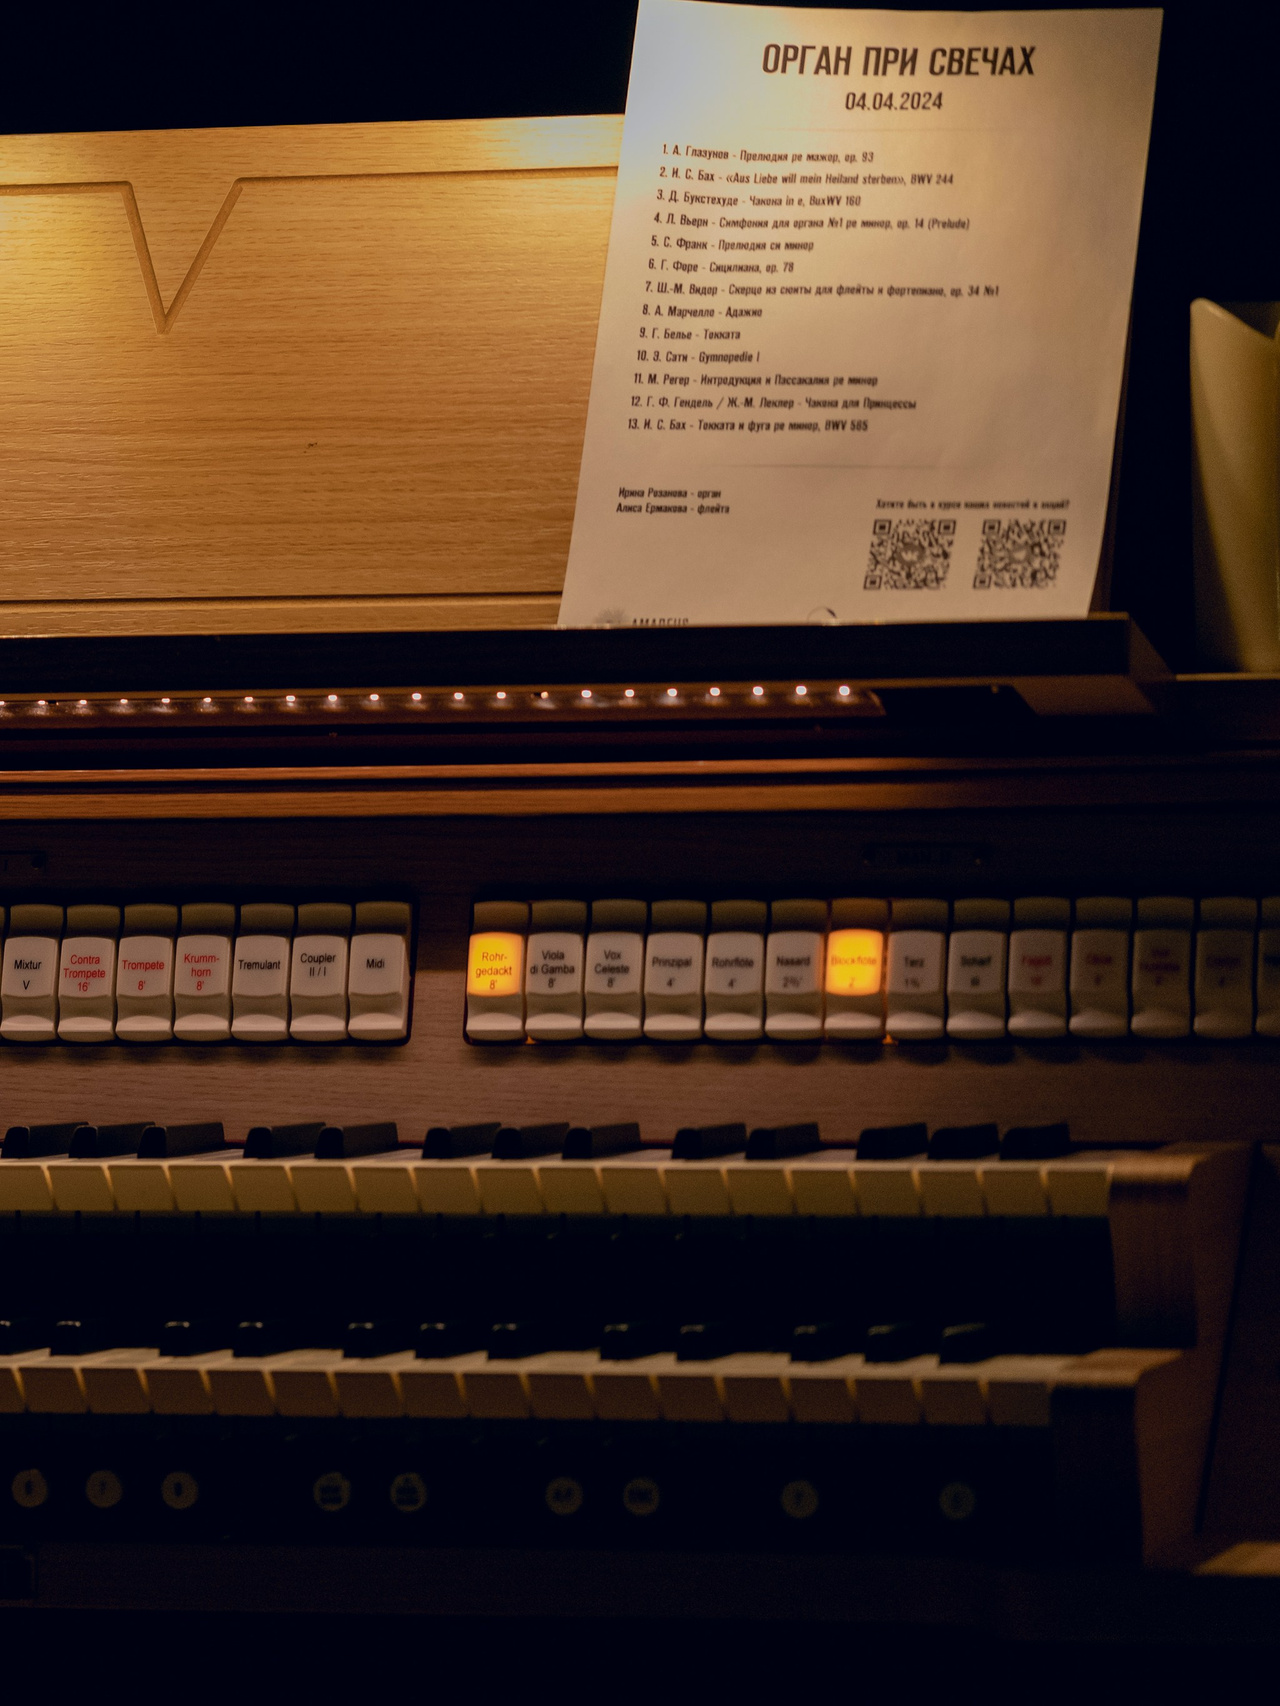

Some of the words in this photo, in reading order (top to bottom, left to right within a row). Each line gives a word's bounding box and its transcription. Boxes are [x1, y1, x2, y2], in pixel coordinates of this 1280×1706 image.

[762, 43, 853, 77] ОРГАН
[861, 45, 919, 77] ПРИ
[928, 45, 1037, 77] СВЕЧАХ
[844, 91, 943, 111] 04.04.2024
[672, 144, 682, 156] А.
[685, 145, 730, 161] Глазунов
[739, 149, 789, 164] Прелюдия
[861, 151, 875, 163] 93
[659, 166, 668, 178] 2.
[671, 166, 681, 179] И.
[684, 168, 694, 181] С.
[697, 169, 715, 182] Бах
[753, 172, 778, 185] Liebe
[781, 172, 797, 185] will
[799, 173, 823, 185] mein
[824, 173, 860, 185] Heiland
[910, 173, 933, 185] BWV
[656, 188, 665, 201] 3.
[683, 191, 739, 208] Букстехуде
[749, 195, 783, 207] Чакона
[785, 194, 795, 207] in
[808, 194, 843, 207] BuxWV
[845, 195, 862, 207] 160
[653, 211, 663, 224] 4.
[679, 213, 709, 229] Вьерн
[718, 216, 769, 231] Симфония
[771, 219, 790, 230] для
[792, 219, 825, 231] органа
[927, 217, 970, 231] (Prelude)
[650, 234, 660, 247] 5.
[663, 235, 673, 248] С.
[675, 236, 708, 252] Франк
[717, 238, 767, 253] Прелюдия
[648, 257, 657, 270] 6.
[660, 258, 669, 271] Г.
[672, 260, 699, 275] Форе
[783, 261, 795, 273] 78
[656, 281, 685, 295] Ш.-М.
[688, 283, 718, 297] Видор
[728, 283, 763, 297] Скерцо
[779, 285, 813, 296] сюиты
[814, 285, 834, 297] для
[835, 283, 875, 297] флейты
[967, 284, 980, 297] 34
[641, 303, 651, 316] 8.
[654, 304, 664, 317] А.
[667, 305, 715, 320] Марчелло
[724, 305, 763, 319] Адажио
[639, 326, 648, 339] 9.
[651, 327, 660, 340] Г.
[663, 327, 693, 341] Белье
[703, 328, 741, 341] Токката
[636, 349, 649, 362] 10.
[665, 350, 689, 363] Сати
[698, 350, 754, 365] Gymnopedie
[634, 372, 644, 385] 11.
[647, 372, 660, 385] М.
[662, 372, 690, 388] Регер
[700, 373, 763, 388] Интродукция
[773, 373, 830, 387] Пассакалия
[631, 395, 643, 407] 12.
[646, 395, 655, 408] Г.
[658, 396, 670, 408] Ф.
[673, 396, 714, 410] Гендель
[804, 396, 839, 409] Чакона
[840, 399, 861, 410] для
[627, 417, 640, 430] 13.
[643, 418, 653, 430] И.
[656, 418, 666, 431] С.
[669, 418, 687, 431] Бах
[698, 418, 736, 432] Токката
[747, 419, 772, 434] фуга
[824, 418, 848, 432] BWV
[617, 486, 646, 500] Ирина
[647, 486, 688, 499] Розанова
[615, 501, 643, 514] Алиса
[644, 501, 688, 515] Ермакова
[696, 502, 731, 516] флейта
[69, 954, 101, 965] Contra
[183, 953, 220, 964] Krumm-
[300, 952, 336, 966] Coupler
[481, 951, 508, 962] Rohr-
[542, 950, 565, 961] Viola
[604, 950, 622, 960] Vox
[13, 959, 42, 971] Mixtur
[122, 959, 165, 972] Trompete
[238, 958, 281, 970] Tremulant
[365, 957, 386, 969] Midi
[594, 963, 630, 974] Celeste
[652, 956, 693, 968] Prinzipal
[63, 967, 106, 980] Trompete
[190, 966, 212, 977] horn
[476, 966, 513, 979] gedackt
[530, 963, 539, 974] di
[541, 964, 575, 975] Gamba
[22, 980, 30, 990] V
[76, 982, 91, 992] 16'
[137, 980, 146, 990] 8'
[196, 980, 205, 991] 8'
[489, 980, 498, 990] 8'
[548, 978, 557, 988] 8'
